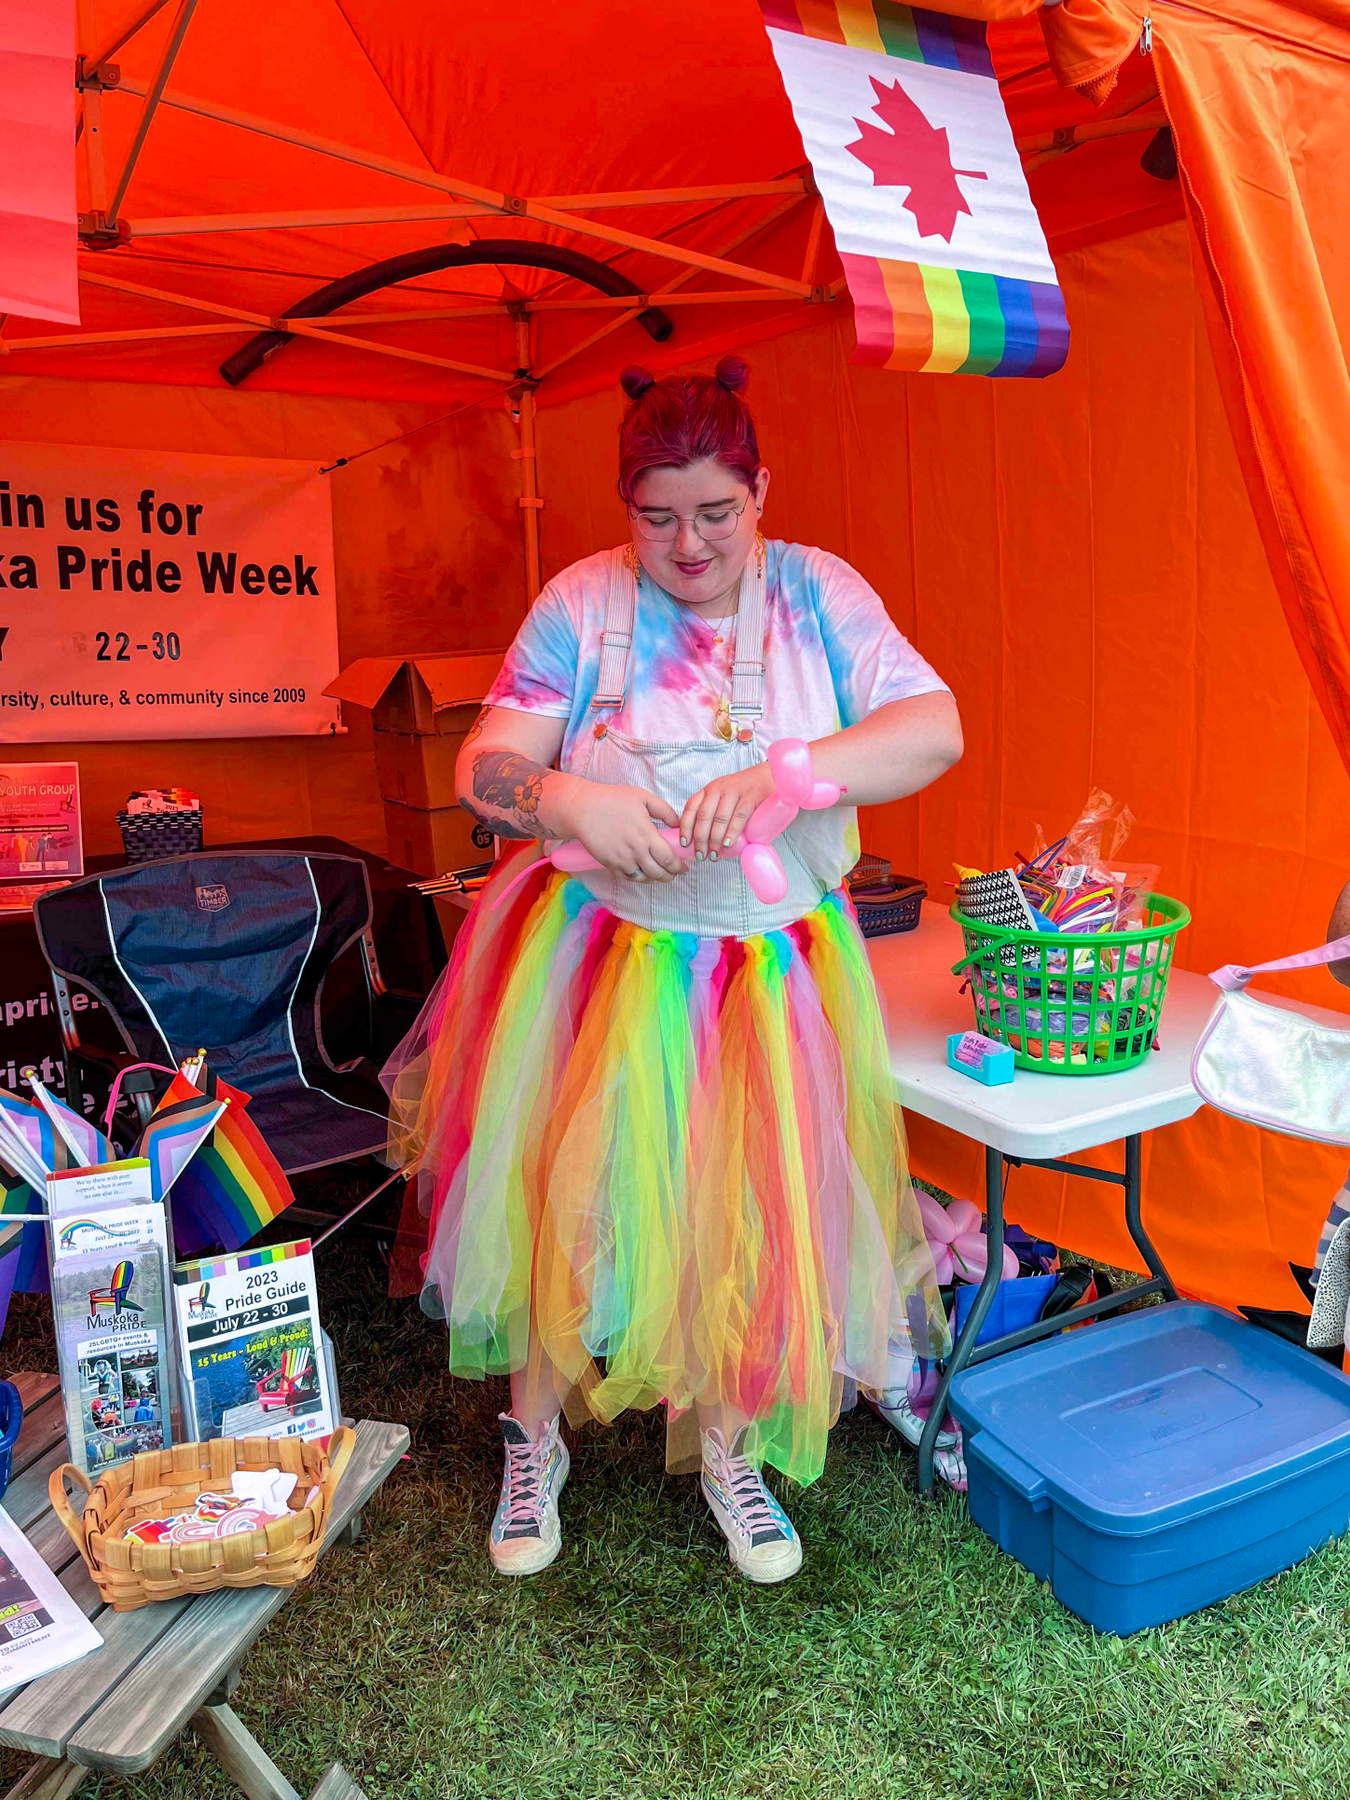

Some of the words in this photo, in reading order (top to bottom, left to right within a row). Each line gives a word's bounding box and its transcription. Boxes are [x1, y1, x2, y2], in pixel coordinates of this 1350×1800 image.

[65, 496, 120, 532] us
[137, 490, 203, 536] for
[57, 545, 182, 593] Pride
[197, 551, 320, 596] Week
[50, 690, 114, 708] culture,
[119, 690, 131, 705] &
[136, 689, 224, 708] community
[228, 689, 269, 704] since
[273, 688, 306, 703] 2009
[0, 786, 36, 796] YOUTH
[39, 784, 76, 795] GROUP
[477, 833, 490, 845] 50
[199, 897, 227, 908] TIMBER
[245, 1270, 279, 1290] 2023
[225, 1292, 262, 1311] Pride
[266, 1281, 307, 1302] Guide
[87, 1312, 139, 1330] Muskoka
[188, 1308, 215, 1320] Muskoka
[211, 1316, 239, 1334] July
[242, 1310, 260, 1325] 22
[272, 1302, 288, 1317] 30
[112, 1320, 147, 1333] PRIDE
[86, 1345, 117, 1354] resources
[125, 1339, 151, 1347] Muskoka
[197, 1357, 210, 1368] 15
[211, 1349, 237, 1365] Years
[245, 1339, 269, 1354] Loud
[270, 1334, 277, 1346] &
[279, 1328, 309, 1344] Proud!
